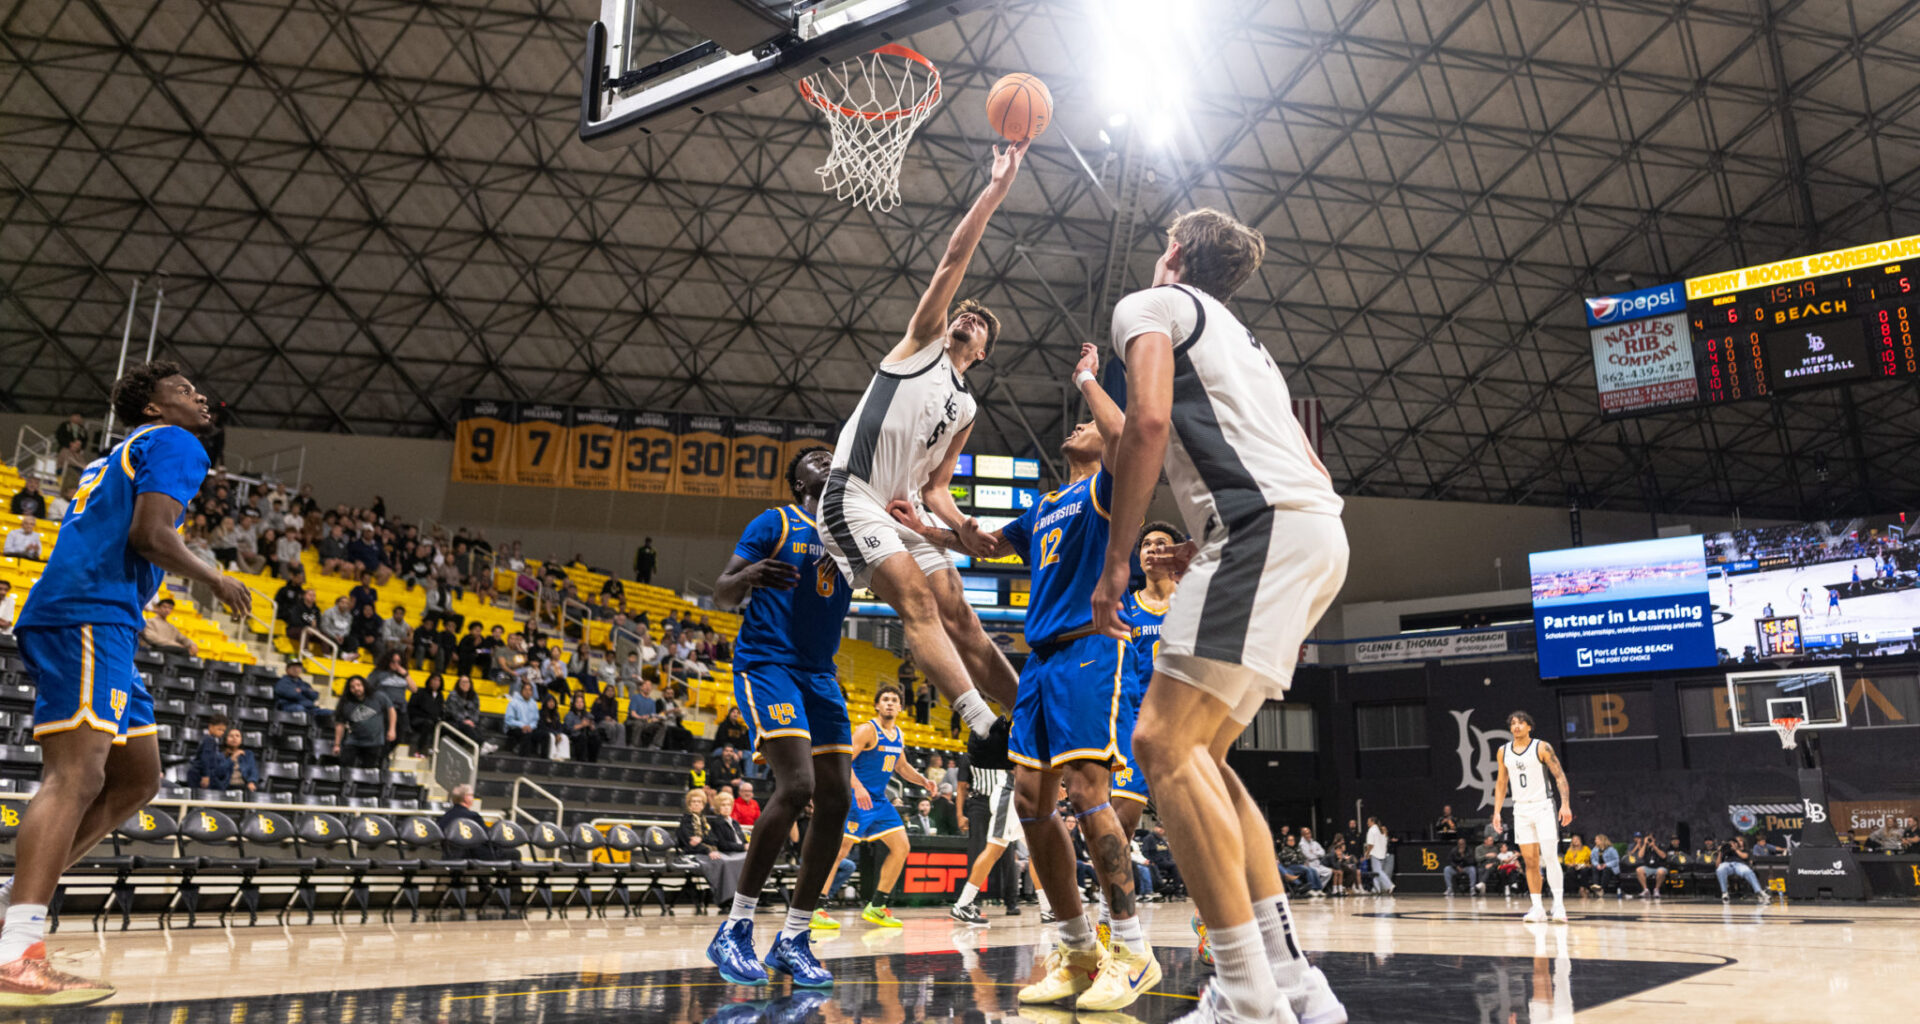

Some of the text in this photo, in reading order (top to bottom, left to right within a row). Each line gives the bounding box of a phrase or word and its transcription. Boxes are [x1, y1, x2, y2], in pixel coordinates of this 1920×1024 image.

[1689, 238, 1920, 296] PERRY MOORE SCOREBOARD
[1771, 281, 1815, 303] 15:19
[1900, 277, 1911, 292] 5
[1621, 288, 1675, 316] pepsi
[1713, 295, 1736, 306] BEACH
[1728, 308, 1738, 324] 6
[1755, 307, 1764, 321] 0
[1774, 300, 1848, 324] BEACH
[1604, 320, 1674, 348] NAPLES
[1694, 320, 1704, 330] 4
[1608, 341, 1678, 366] COMPANY
[1624, 335, 1660, 354] RIB
[1784, 360, 1854, 378] BASKETBALL
[1802, 354, 1834, 366] MEN'S
[1602, 361, 1690, 384] 562-439-7427
[470, 426, 496, 464] 9
[528, 430, 552, 467] 7
[578, 434, 614, 470] 15
[626, 437, 672, 474] 32
[680, 440, 726, 477] 30
[734, 443, 780, 481] 20
[1040, 501, 1083, 530] RIVERSIDE
[792, 542, 807, 554] UC
[863, 536, 880, 550] LB
[1039, 528, 1062, 571] 12
[1544, 604, 1702, 630] Partner in Learning
[1358, 638, 1450, 653] GLENN E. THOMAS
[1456, 633, 1504, 644] #GOBEACH
[1594, 643, 1674, 656] Port of LONG BEACH
[1774, 632, 1796, 654] 12
[1630, 654, 1651, 662] CHOICE
[767, 702, 798, 726] UCR
[1591, 694, 1630, 734] B
[882, 755, 897, 772] 10
[1520, 773, 1528, 788] 0
[1803, 798, 1826, 823] LB
[1851, 814, 1909, 829] Sandar
[1422, 848, 1440, 870] LB
